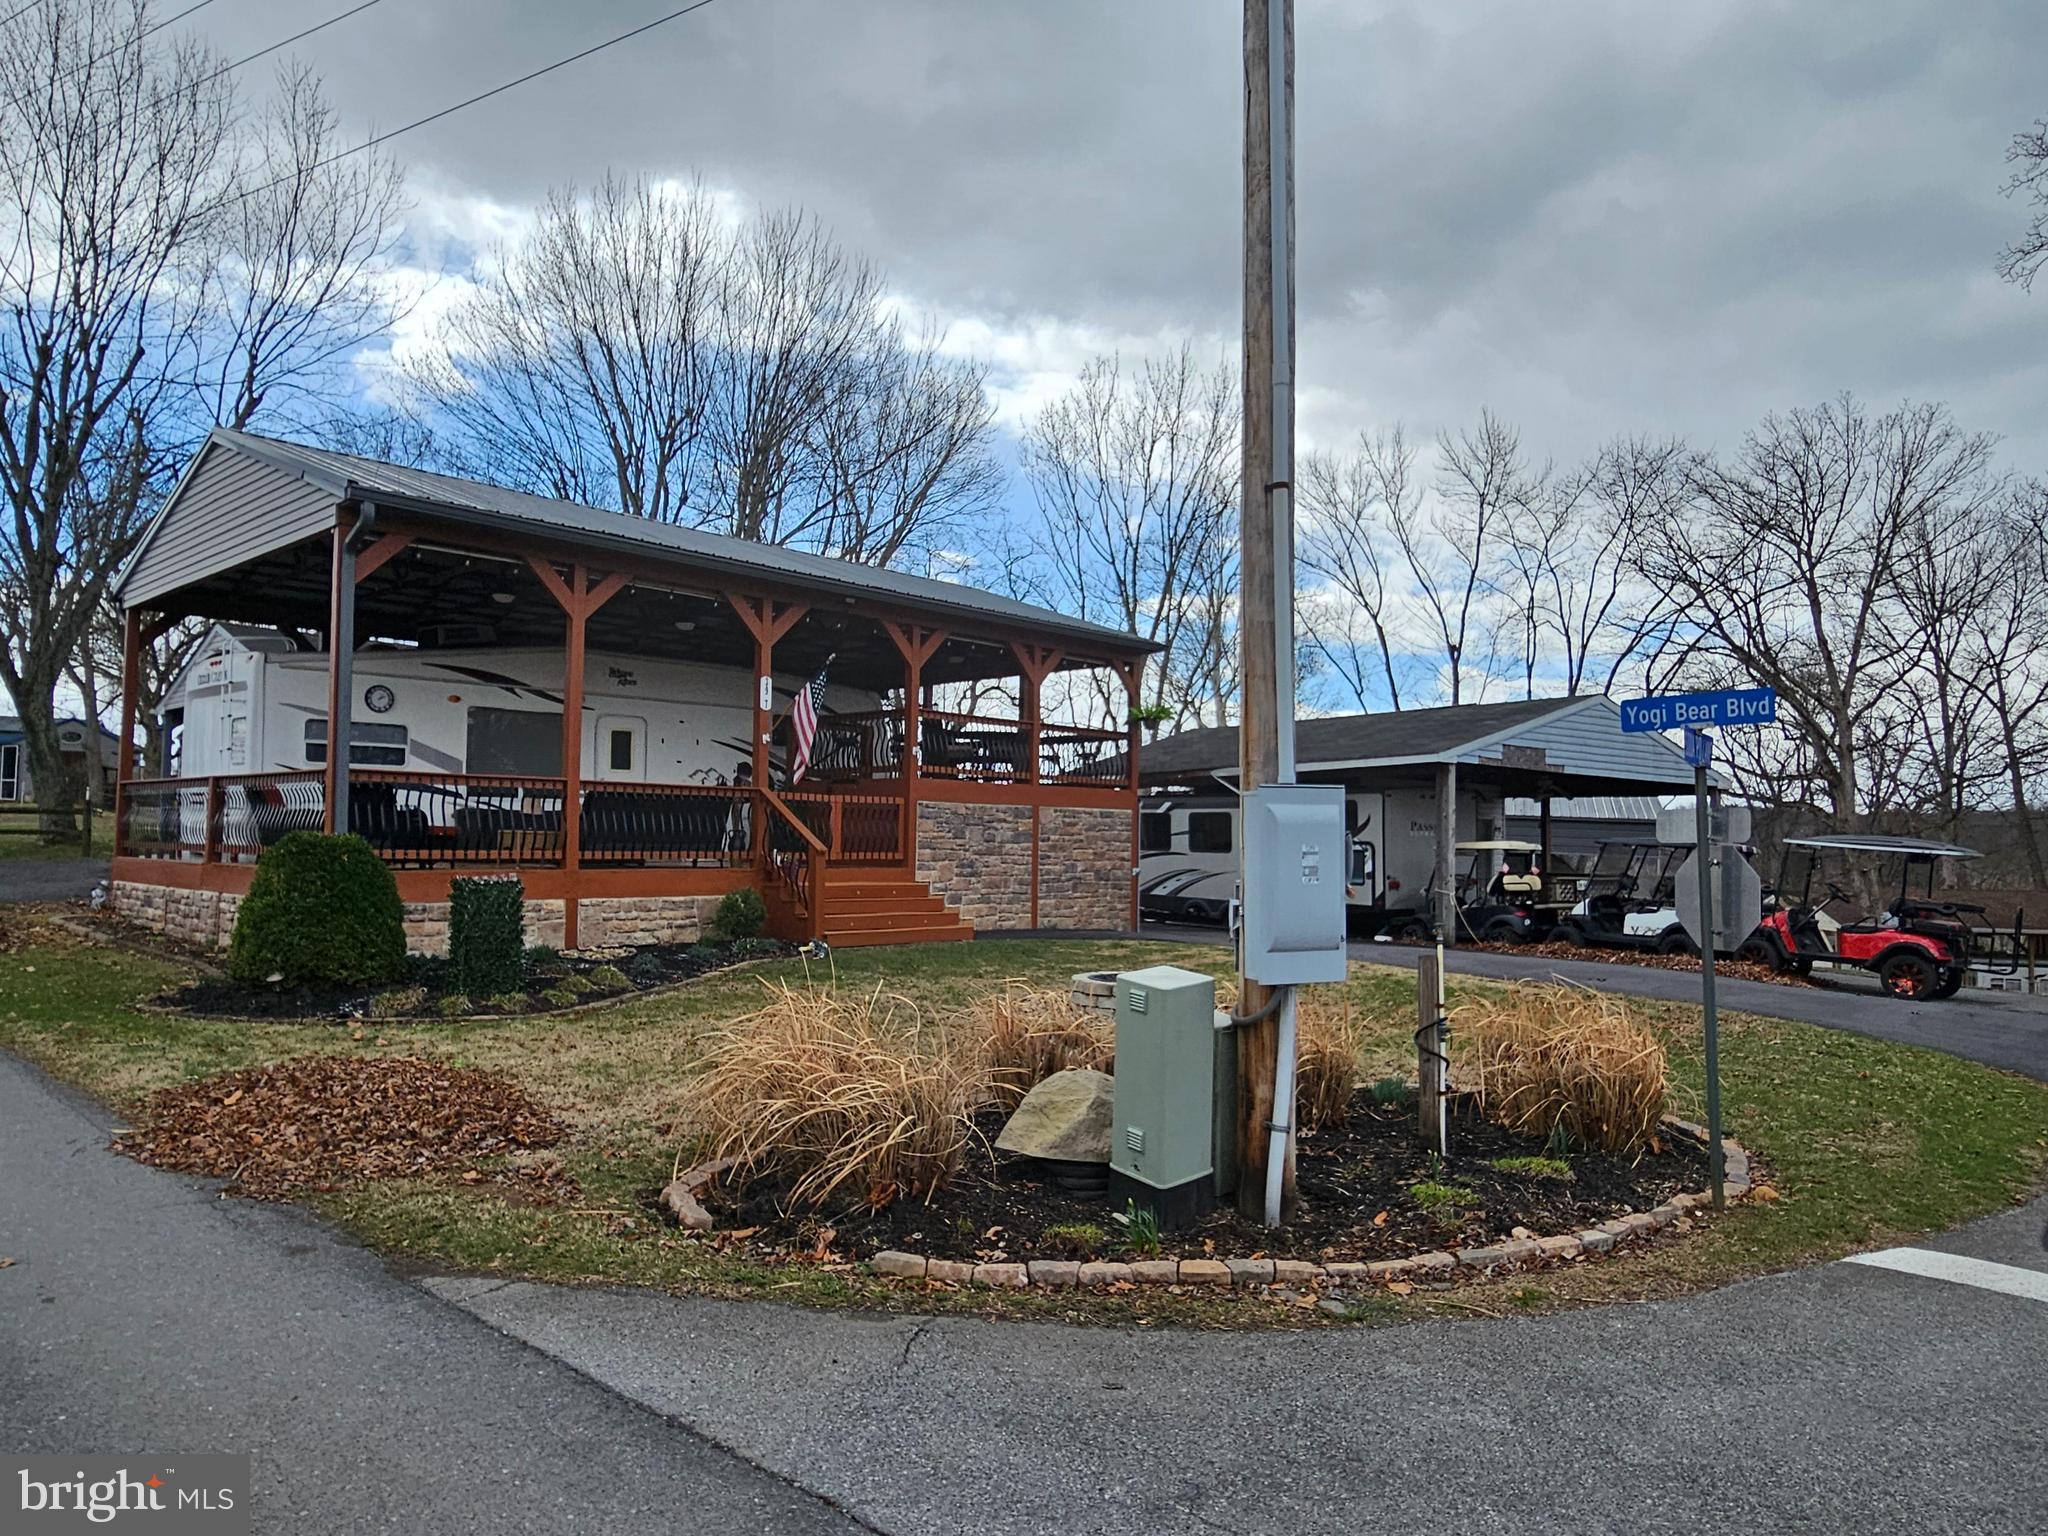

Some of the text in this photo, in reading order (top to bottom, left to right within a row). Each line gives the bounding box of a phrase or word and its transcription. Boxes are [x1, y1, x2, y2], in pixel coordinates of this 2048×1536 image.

[1626, 696, 1770, 728] Yogi Bear Blvd
